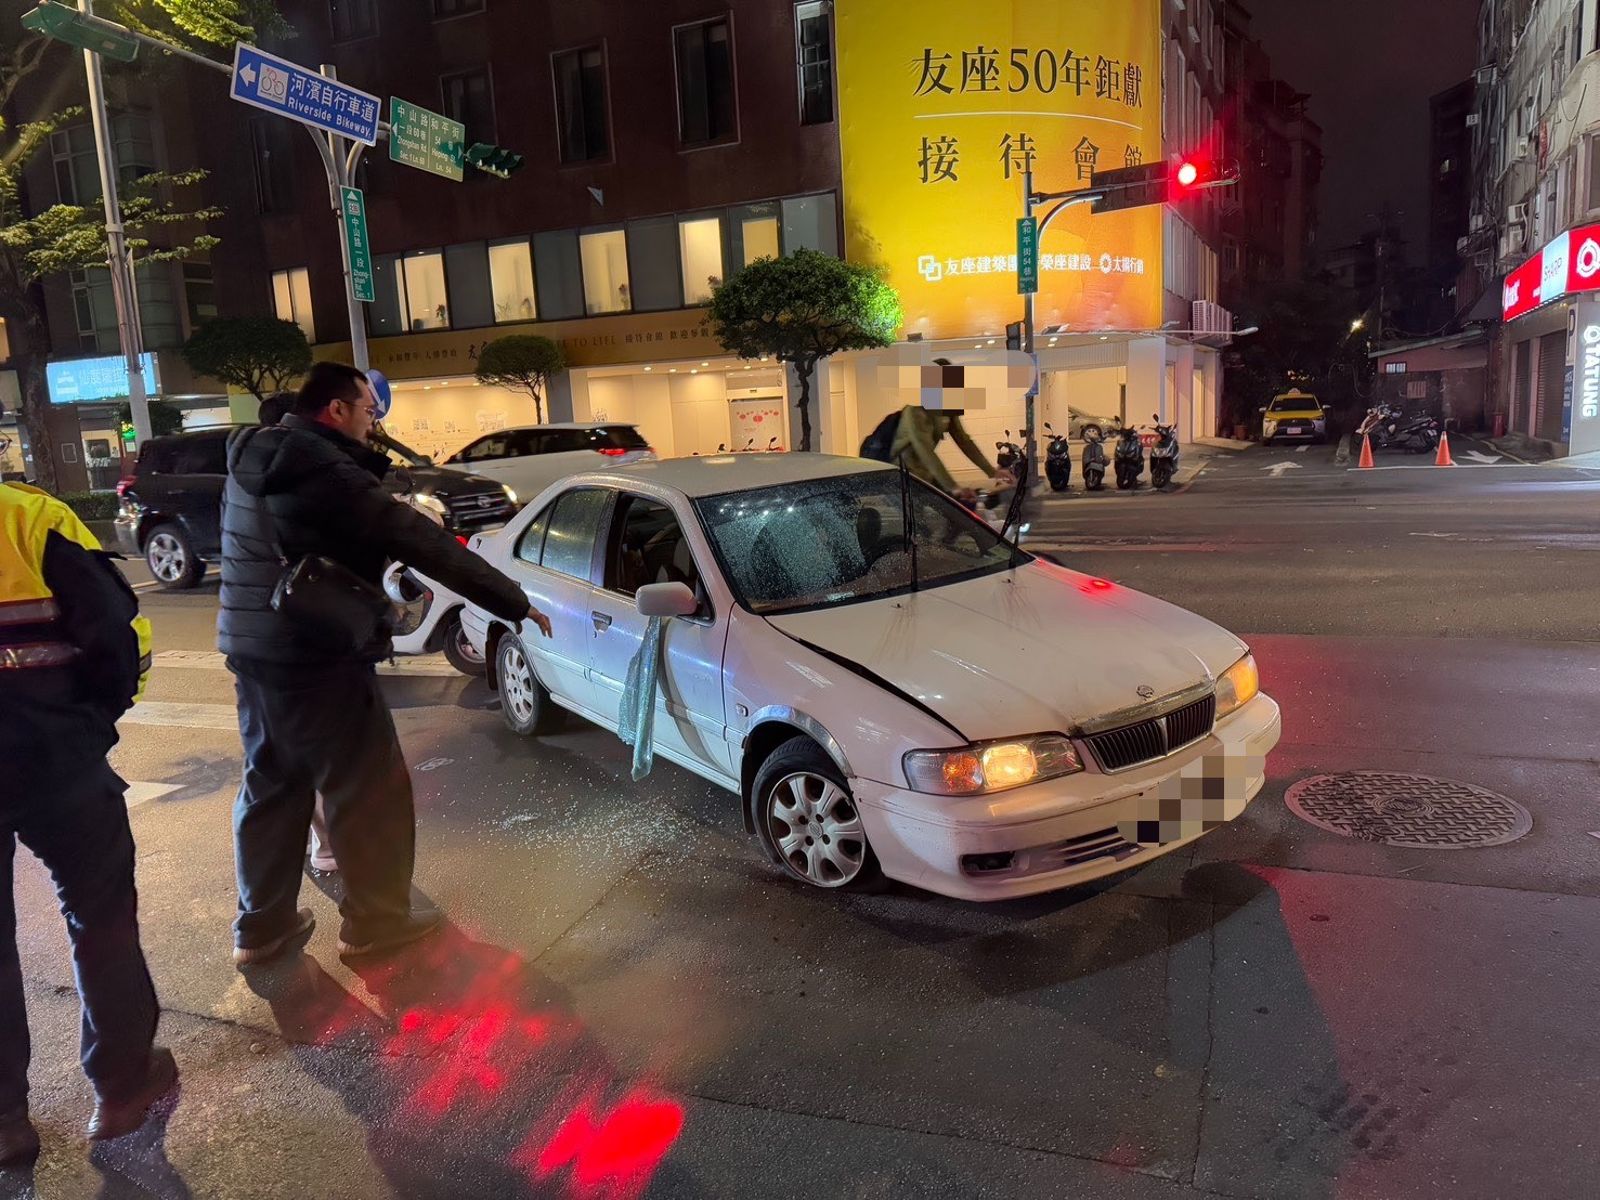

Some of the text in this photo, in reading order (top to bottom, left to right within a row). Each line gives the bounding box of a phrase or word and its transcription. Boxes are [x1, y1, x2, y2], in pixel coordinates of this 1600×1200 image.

[290, 72, 376, 123] 河濱自行車道
[912, 46, 1143, 109] 友座50年鉅獻
[287, 97, 371, 137] Riverside Bikeway
[397, 104, 429, 127] 中山路
[431, 117, 460, 139] 和平街
[351, 217, 364, 268] 中山路一段
[1582, 343, 1600, 418] TATUNG
